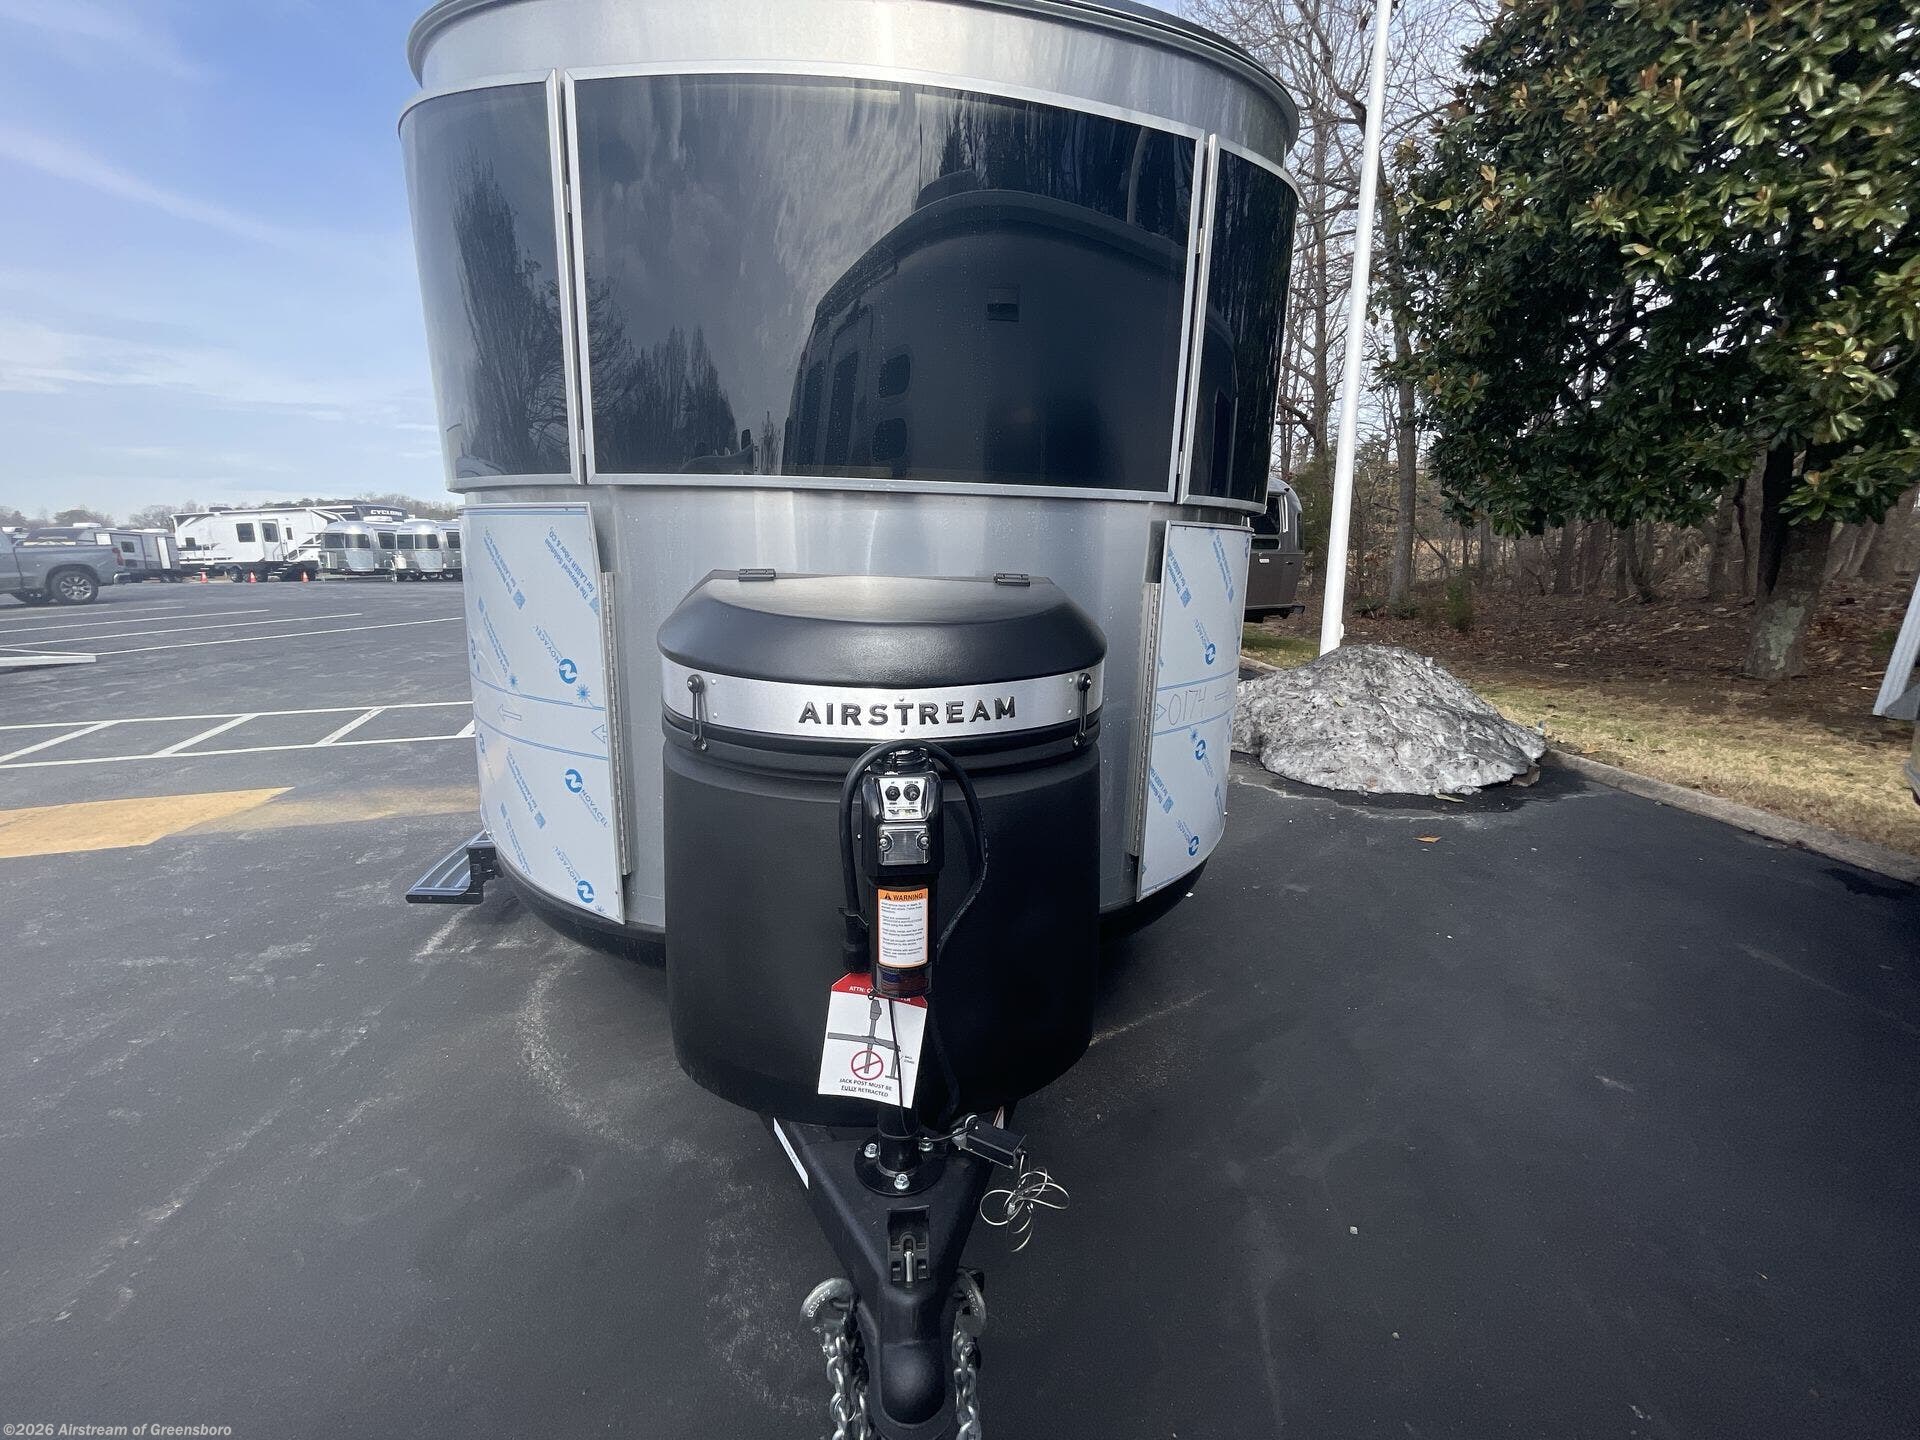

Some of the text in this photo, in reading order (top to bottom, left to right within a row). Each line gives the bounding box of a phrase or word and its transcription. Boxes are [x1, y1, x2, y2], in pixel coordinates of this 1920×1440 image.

[798, 696, 1016, 726] AIRSTREAM
[581, 789, 608, 827] NOVACEL
[893, 892, 923, 901] WARNING
[857, 1087, 889, 1097] RETRACTED
